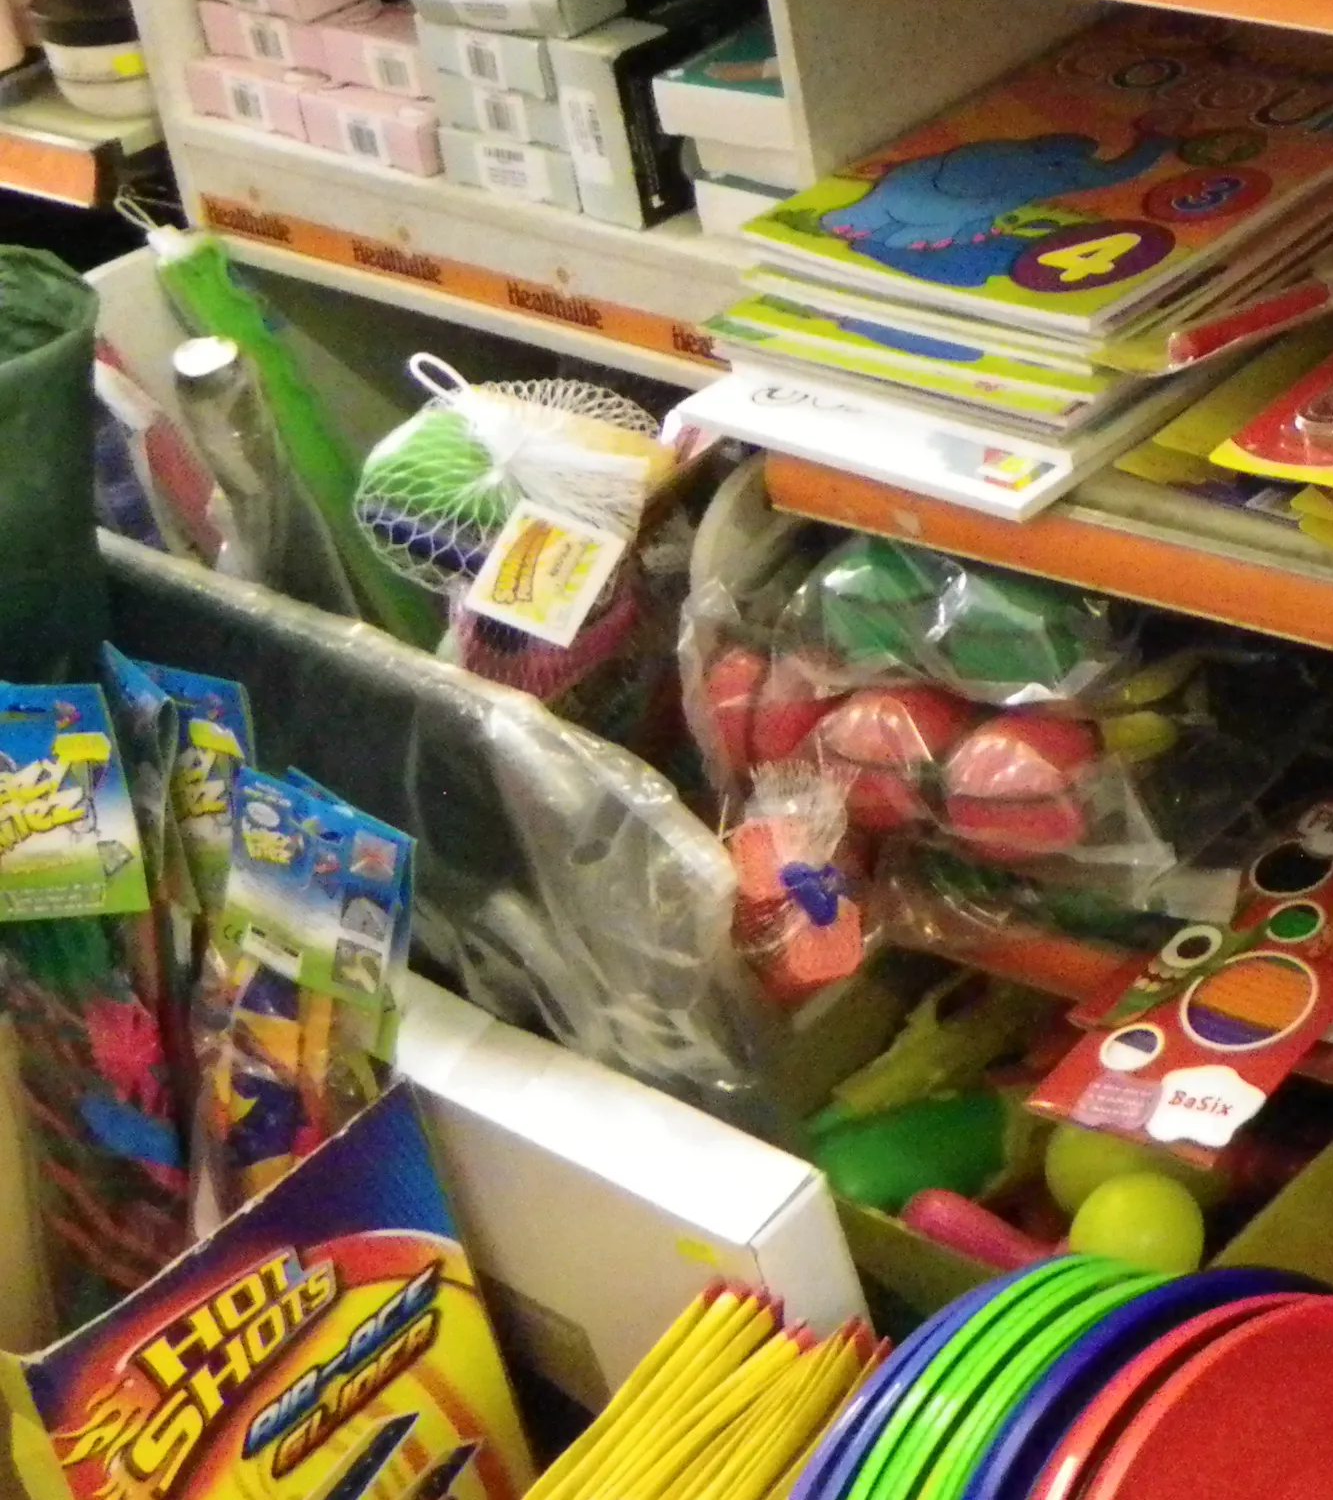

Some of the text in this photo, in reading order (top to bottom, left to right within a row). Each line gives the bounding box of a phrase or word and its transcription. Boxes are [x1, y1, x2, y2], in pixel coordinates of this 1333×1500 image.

[1036, 232, 1143, 283] 4
[130, 1265, 332, 1495] SHOTS
[142, 1255, 291, 1389] HOT
